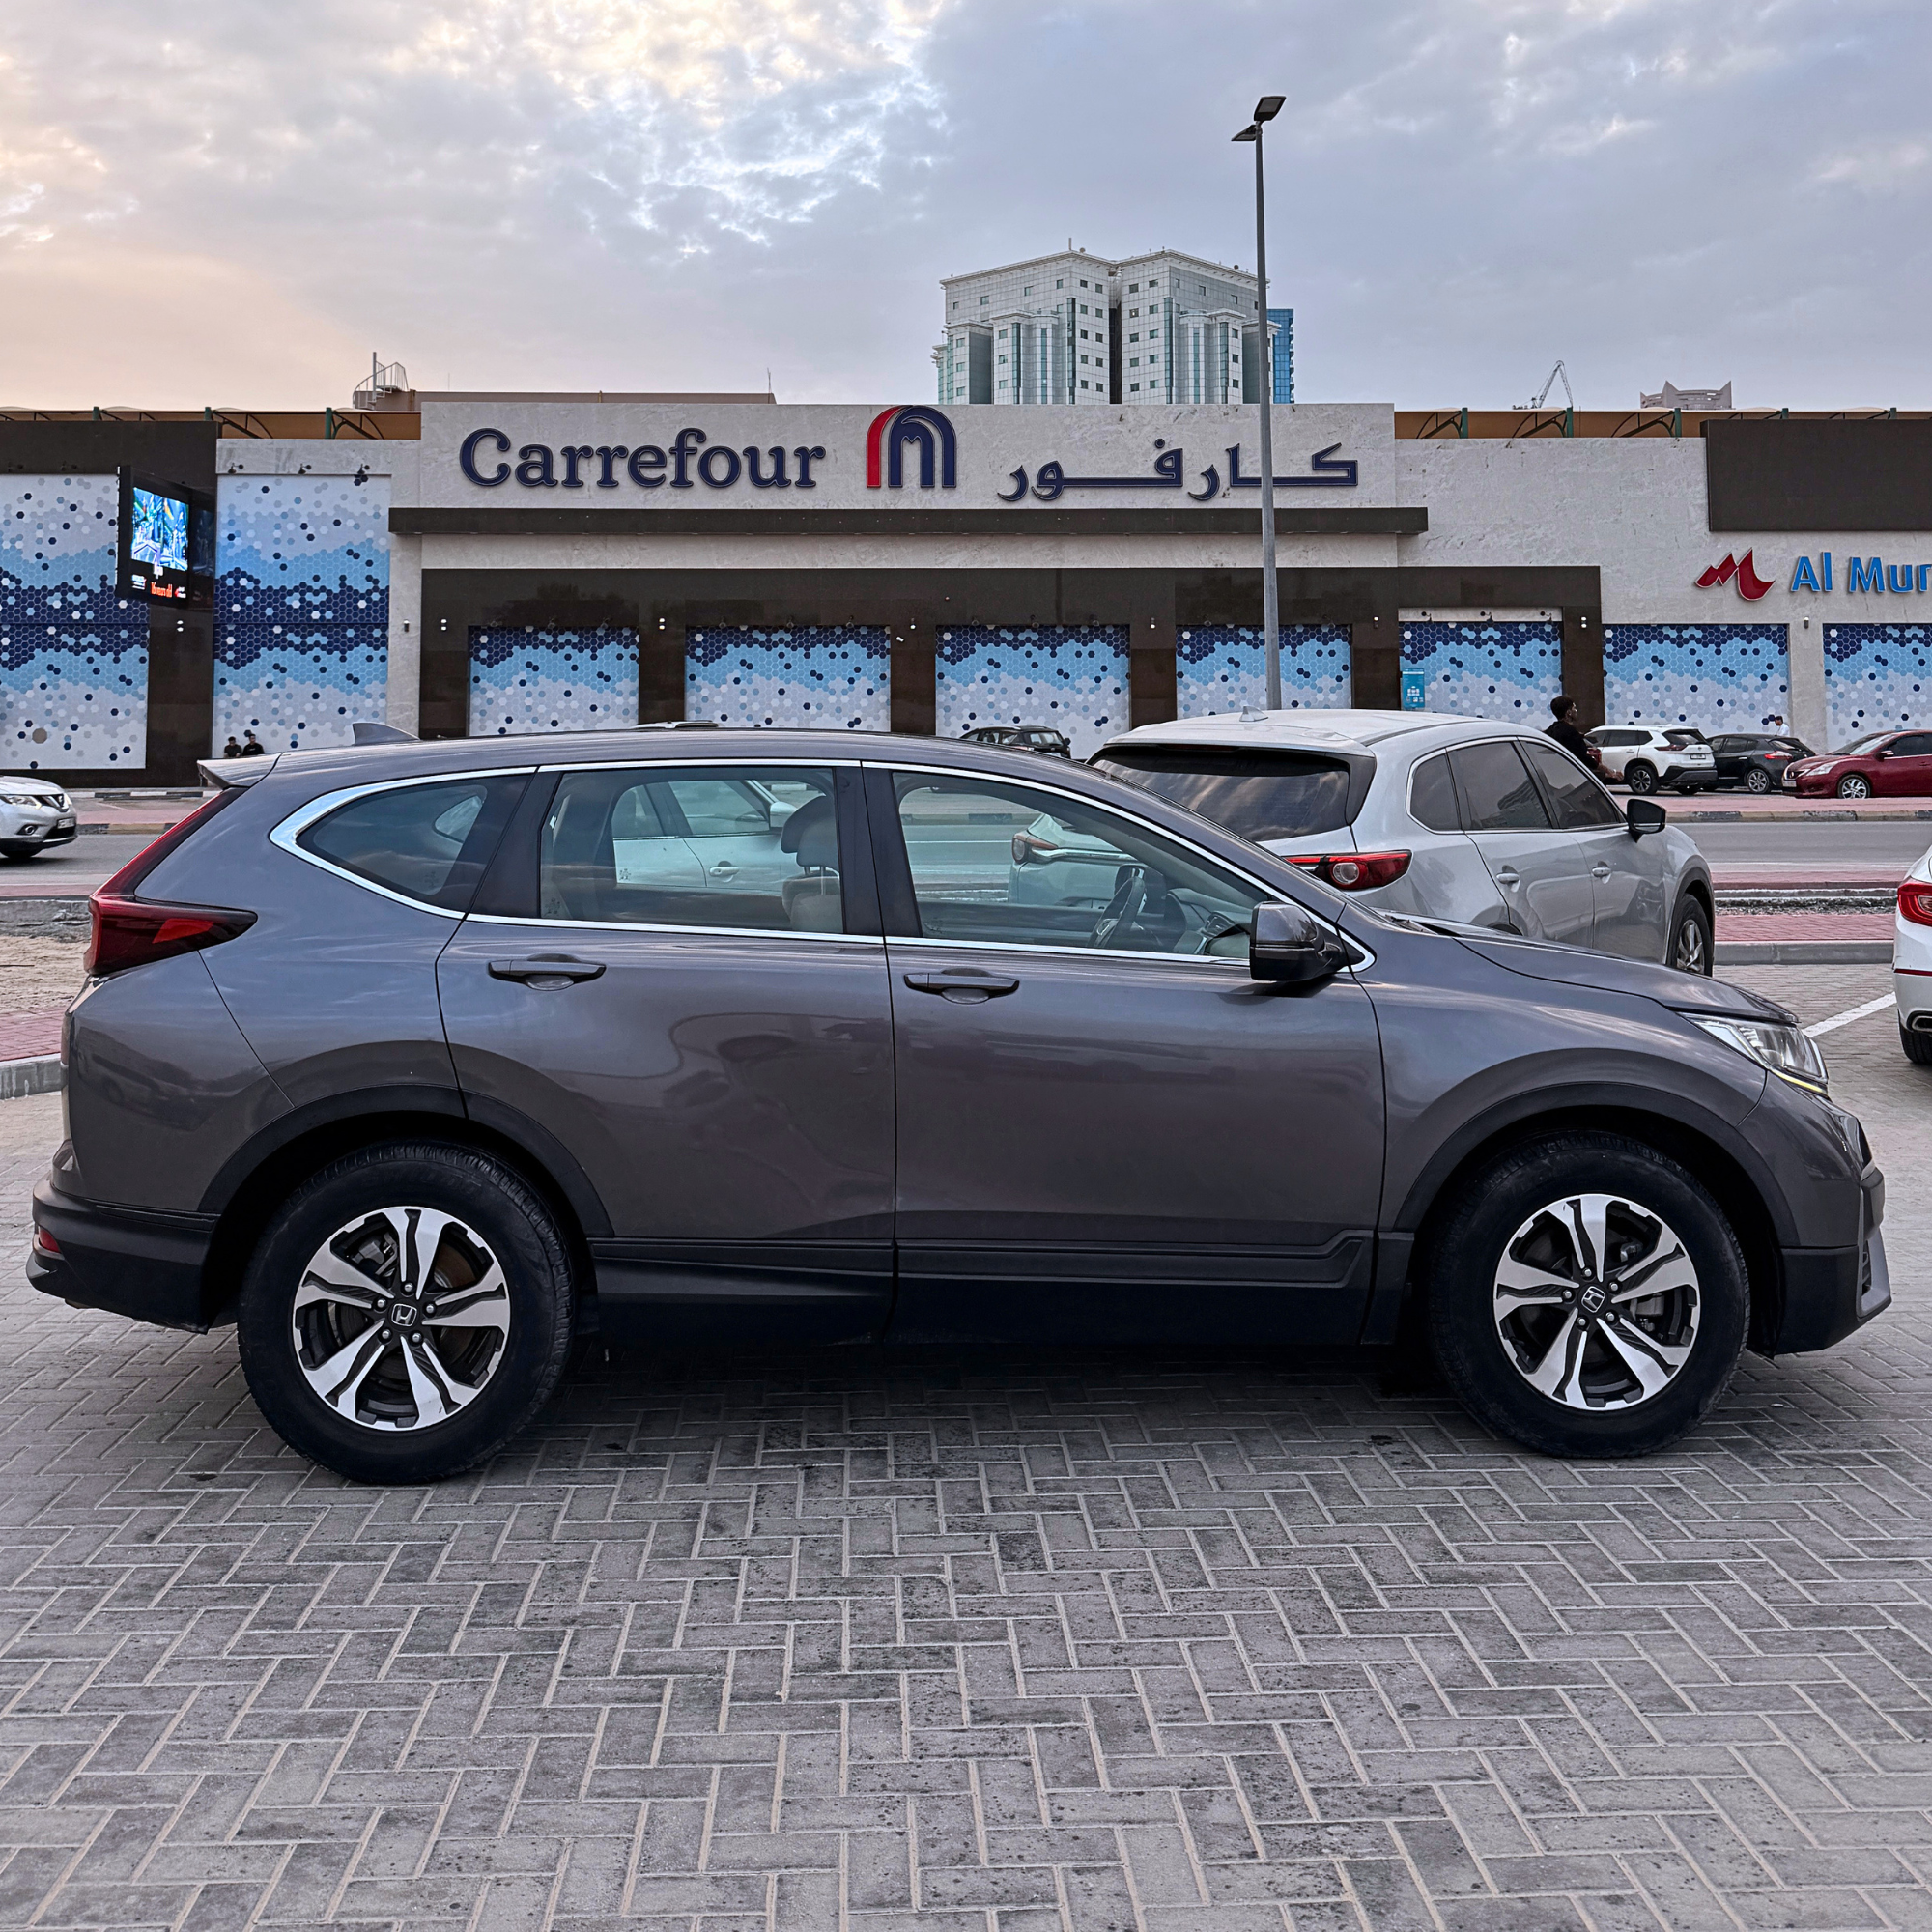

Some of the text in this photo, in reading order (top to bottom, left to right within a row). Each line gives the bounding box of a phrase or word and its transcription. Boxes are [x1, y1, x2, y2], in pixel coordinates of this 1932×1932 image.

[460, 427, 825, 488] Carrefour
[997, 438, 1358, 501] كارفور
[1790, 552, 1932, 593] Al Mur
